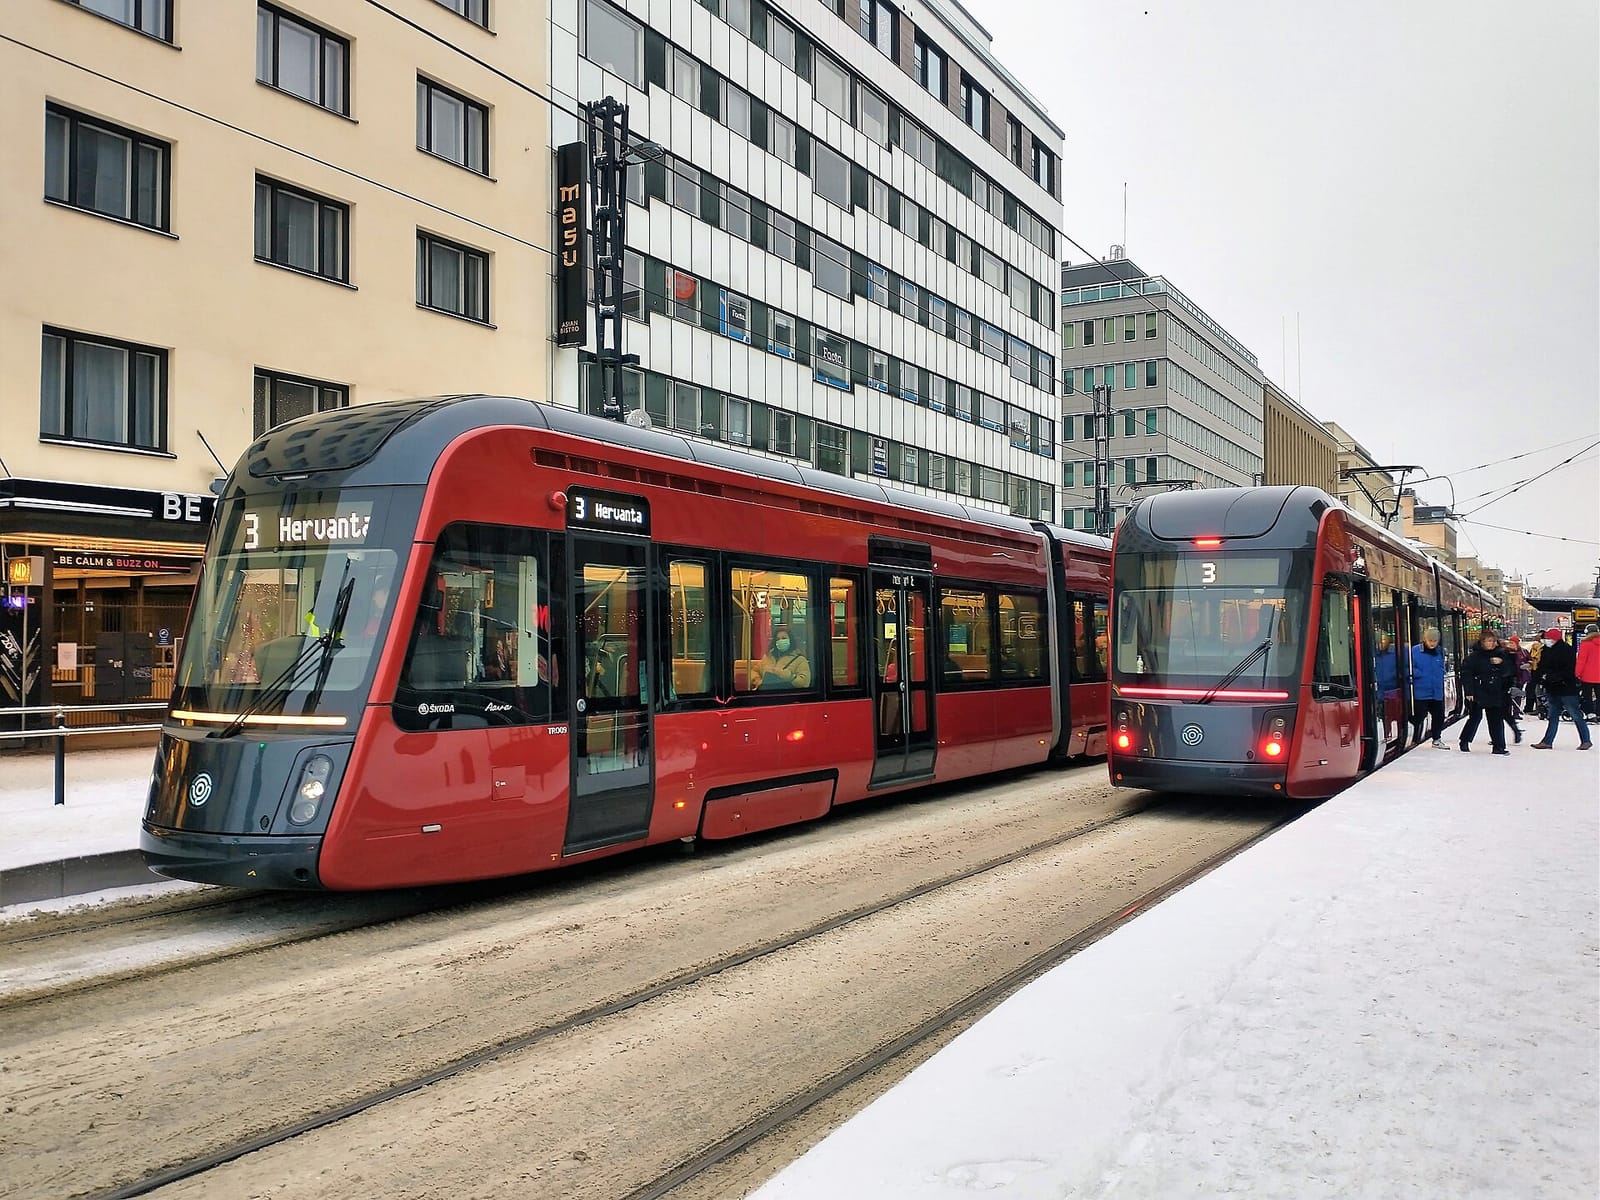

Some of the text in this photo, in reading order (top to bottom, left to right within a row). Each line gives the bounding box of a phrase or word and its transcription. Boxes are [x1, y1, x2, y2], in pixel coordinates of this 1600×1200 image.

[560, 183, 579, 267] masu
[561, 320, 579, 328] ASIAN
[162, 492, 201, 521] BE
[574, 496, 643, 524] 3 Hervanta
[244, 512, 259, 550] 3
[59, 555, 159, 569] BE CALM & BUZZ ON
[1202, 562, 1216, 583] 3
[429, 703, 455, 713] ŠKODA
